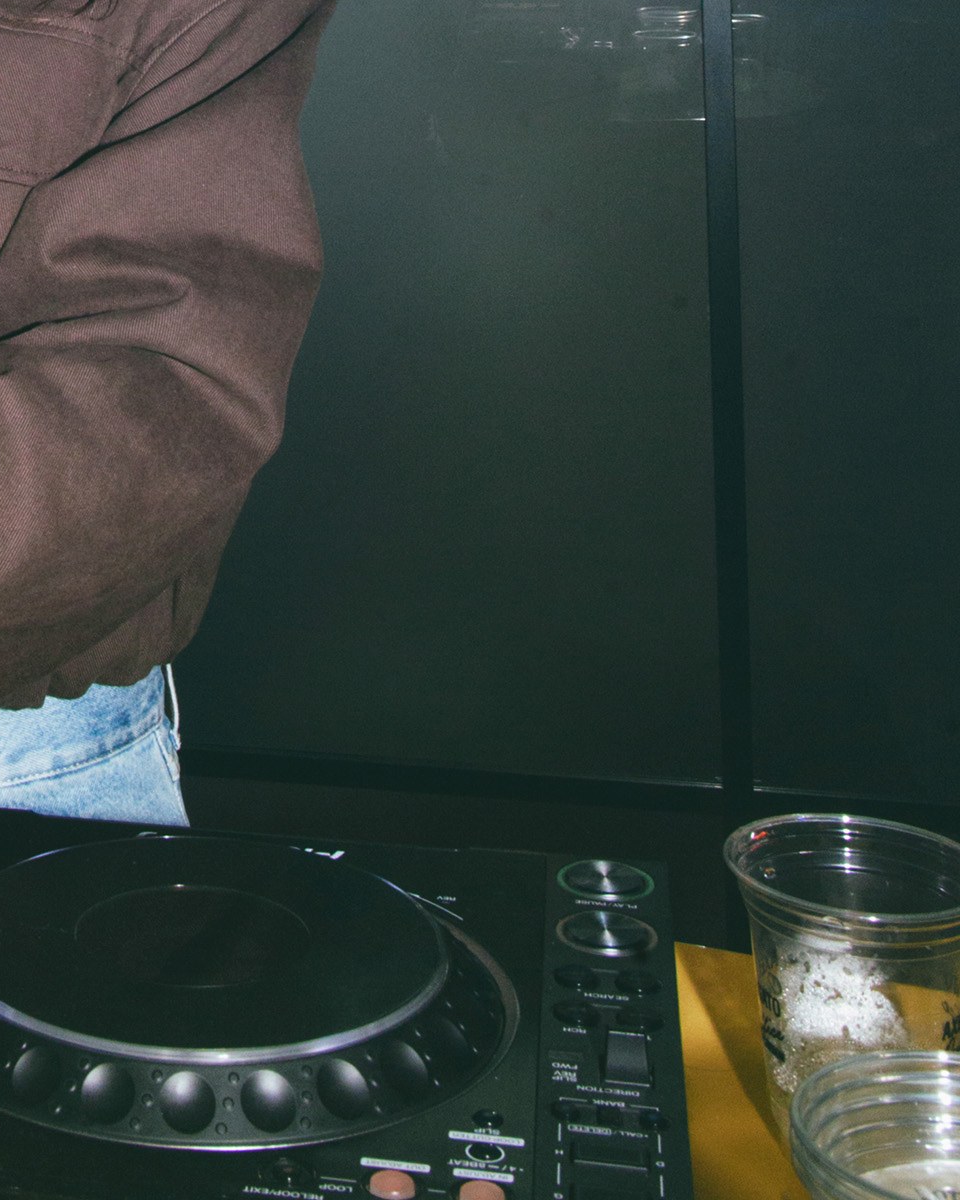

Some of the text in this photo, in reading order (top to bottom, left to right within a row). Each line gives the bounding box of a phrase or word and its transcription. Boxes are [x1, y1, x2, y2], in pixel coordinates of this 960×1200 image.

[551, 1061, 579, 1072] FWD
[576, 1085, 640, 1097] DIRECTION
[591, 1098, 626, 1109] BANK
[319, 1184, 352, 1193] LOOP
